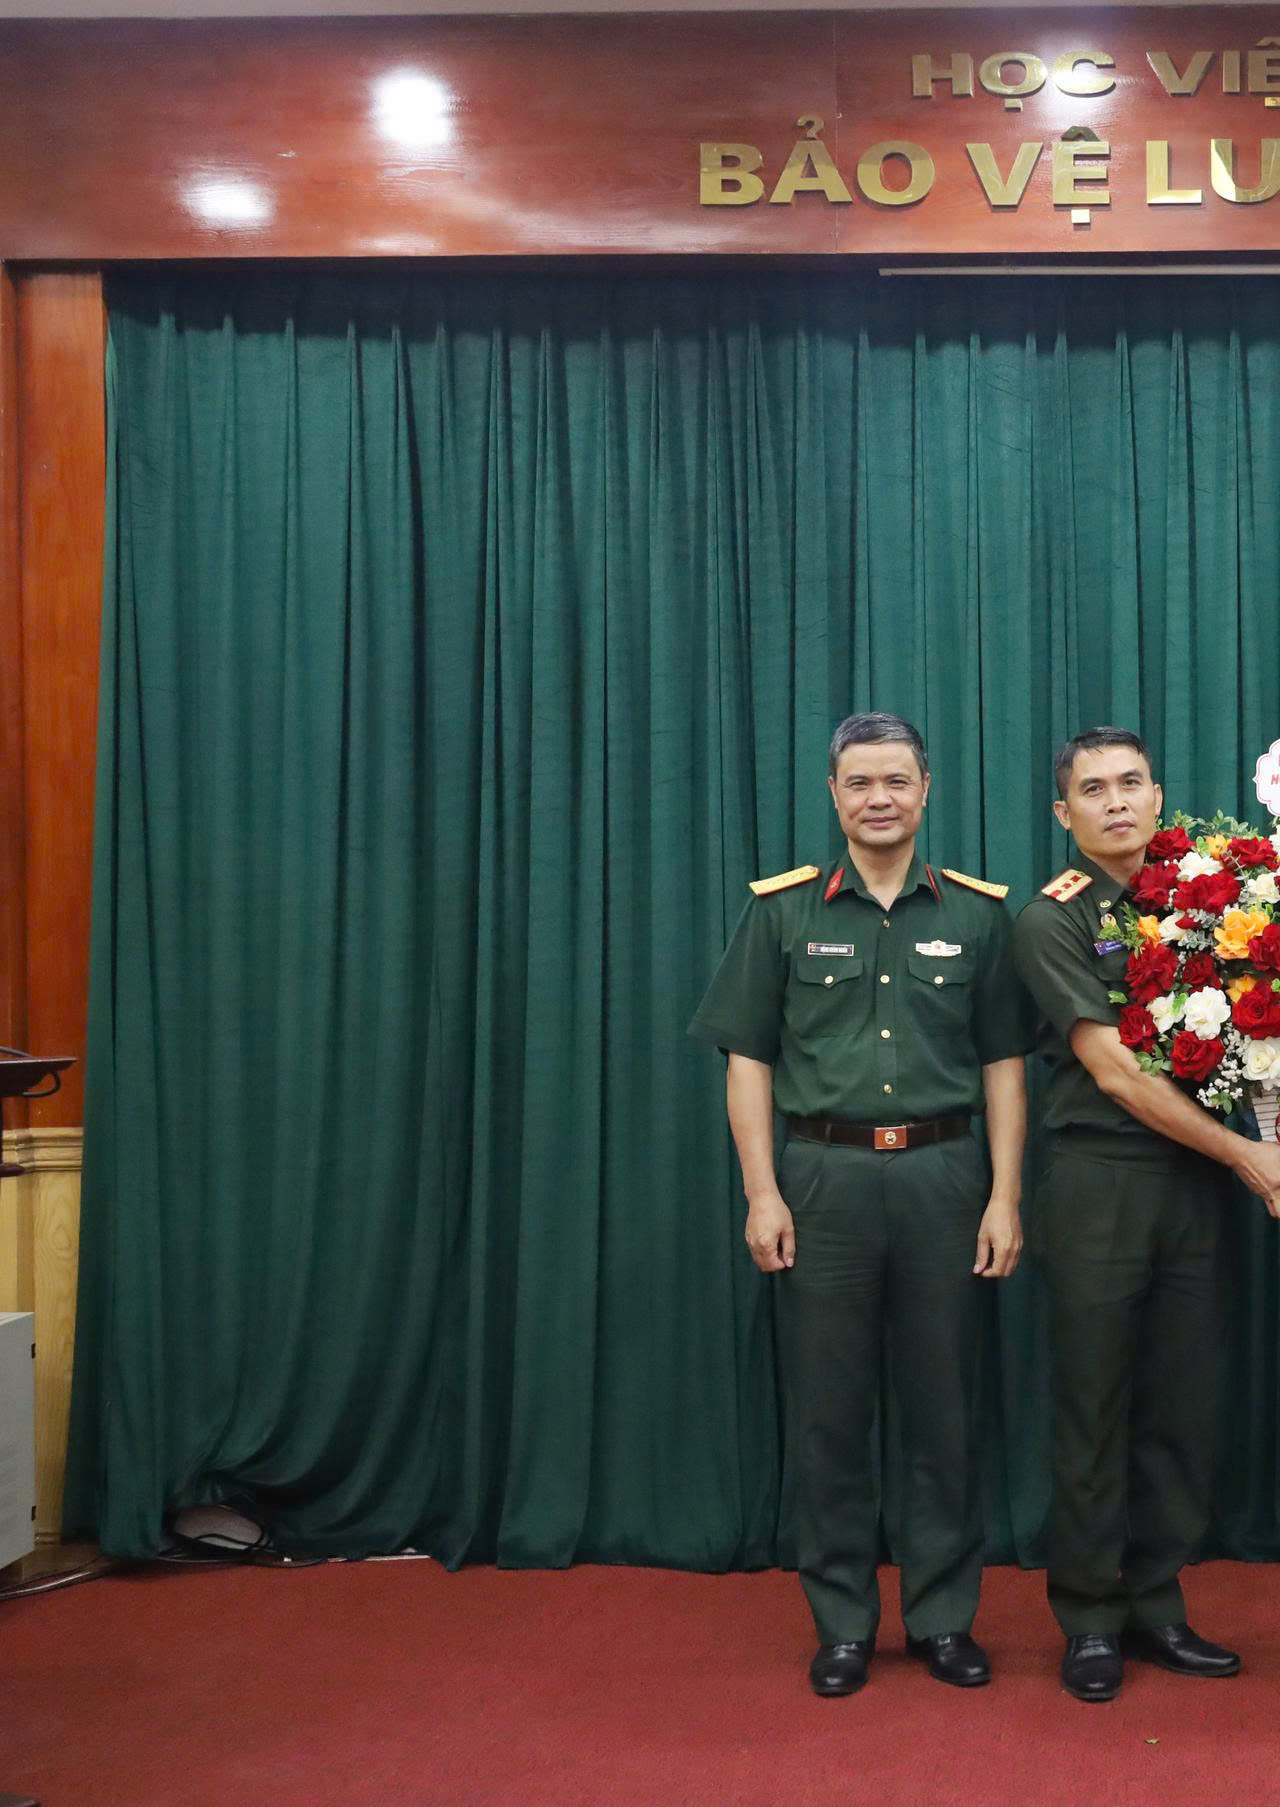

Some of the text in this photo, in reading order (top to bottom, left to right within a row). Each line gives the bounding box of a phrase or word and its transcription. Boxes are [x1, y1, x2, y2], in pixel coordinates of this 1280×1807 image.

[911, 50, 1117, 112] HỌC
[699, 115, 935, 205] BẢO
[965, 125, 1111, 224] VỆ
